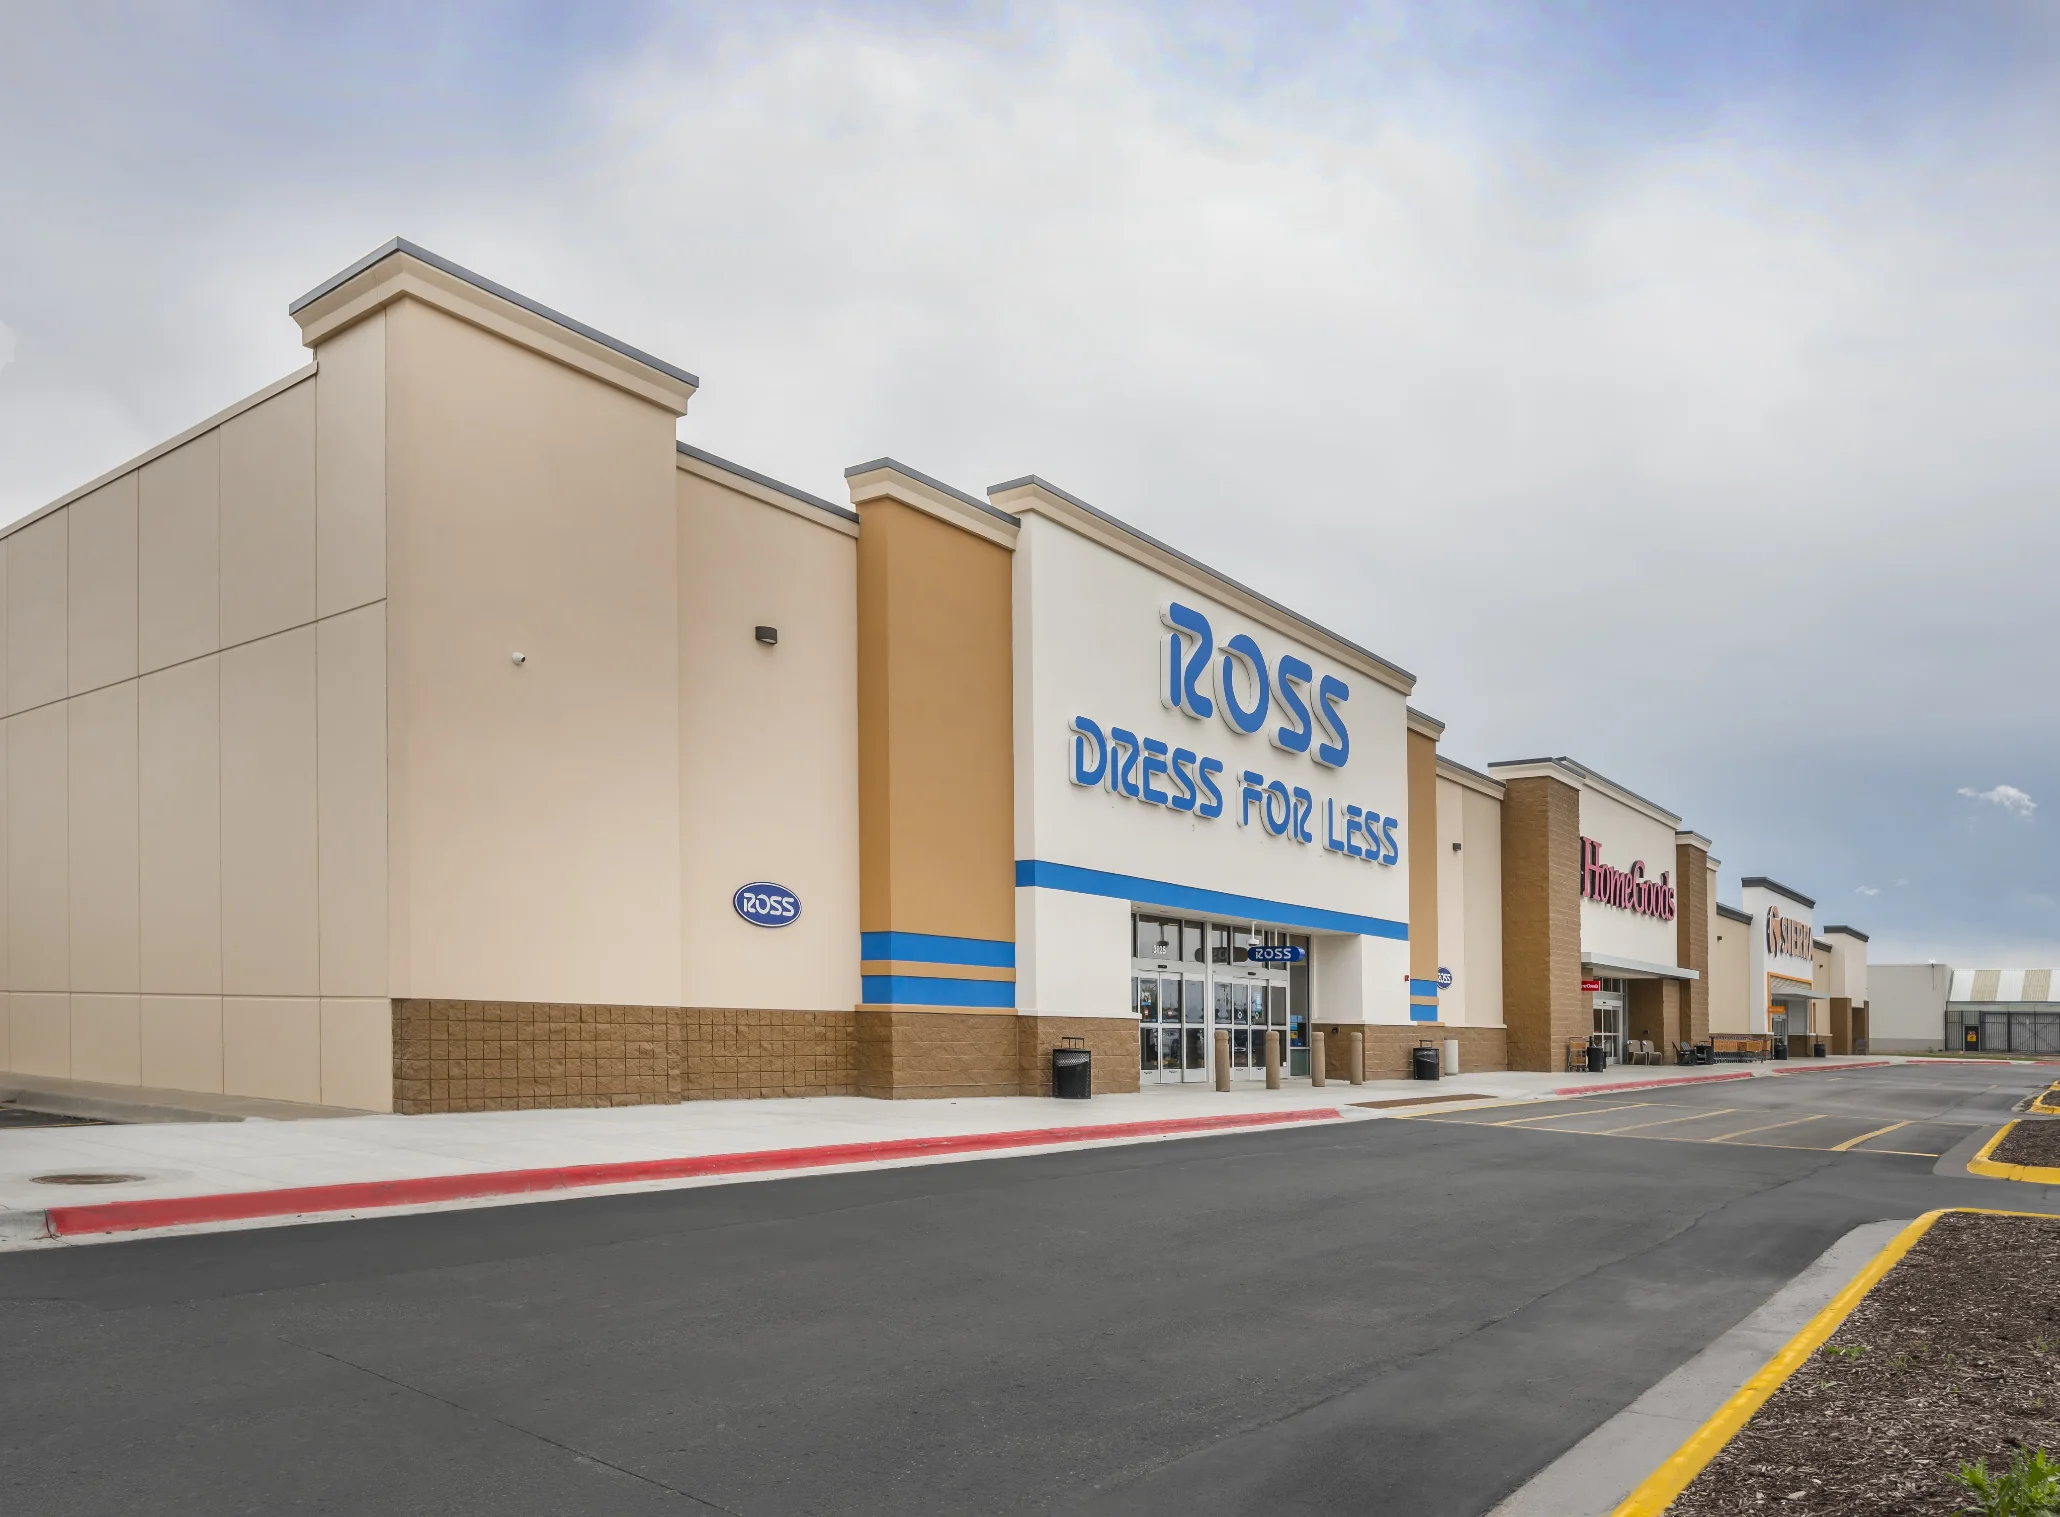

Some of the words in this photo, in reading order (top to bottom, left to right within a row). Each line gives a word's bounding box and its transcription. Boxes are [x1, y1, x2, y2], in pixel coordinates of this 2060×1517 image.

[1159, 602, 1350, 769] ROSS
[1069, 716, 1223, 819] DRESS
[1237, 770, 1312, 844] FOR
[1322, 797, 1398, 866] LESS
[744, 892, 795, 917] ROSS
[1580, 836, 1676, 921] HomeGoods
[1256, 948, 1292, 959] ROSS
[1780, 916, 1813, 961] SIERRA
